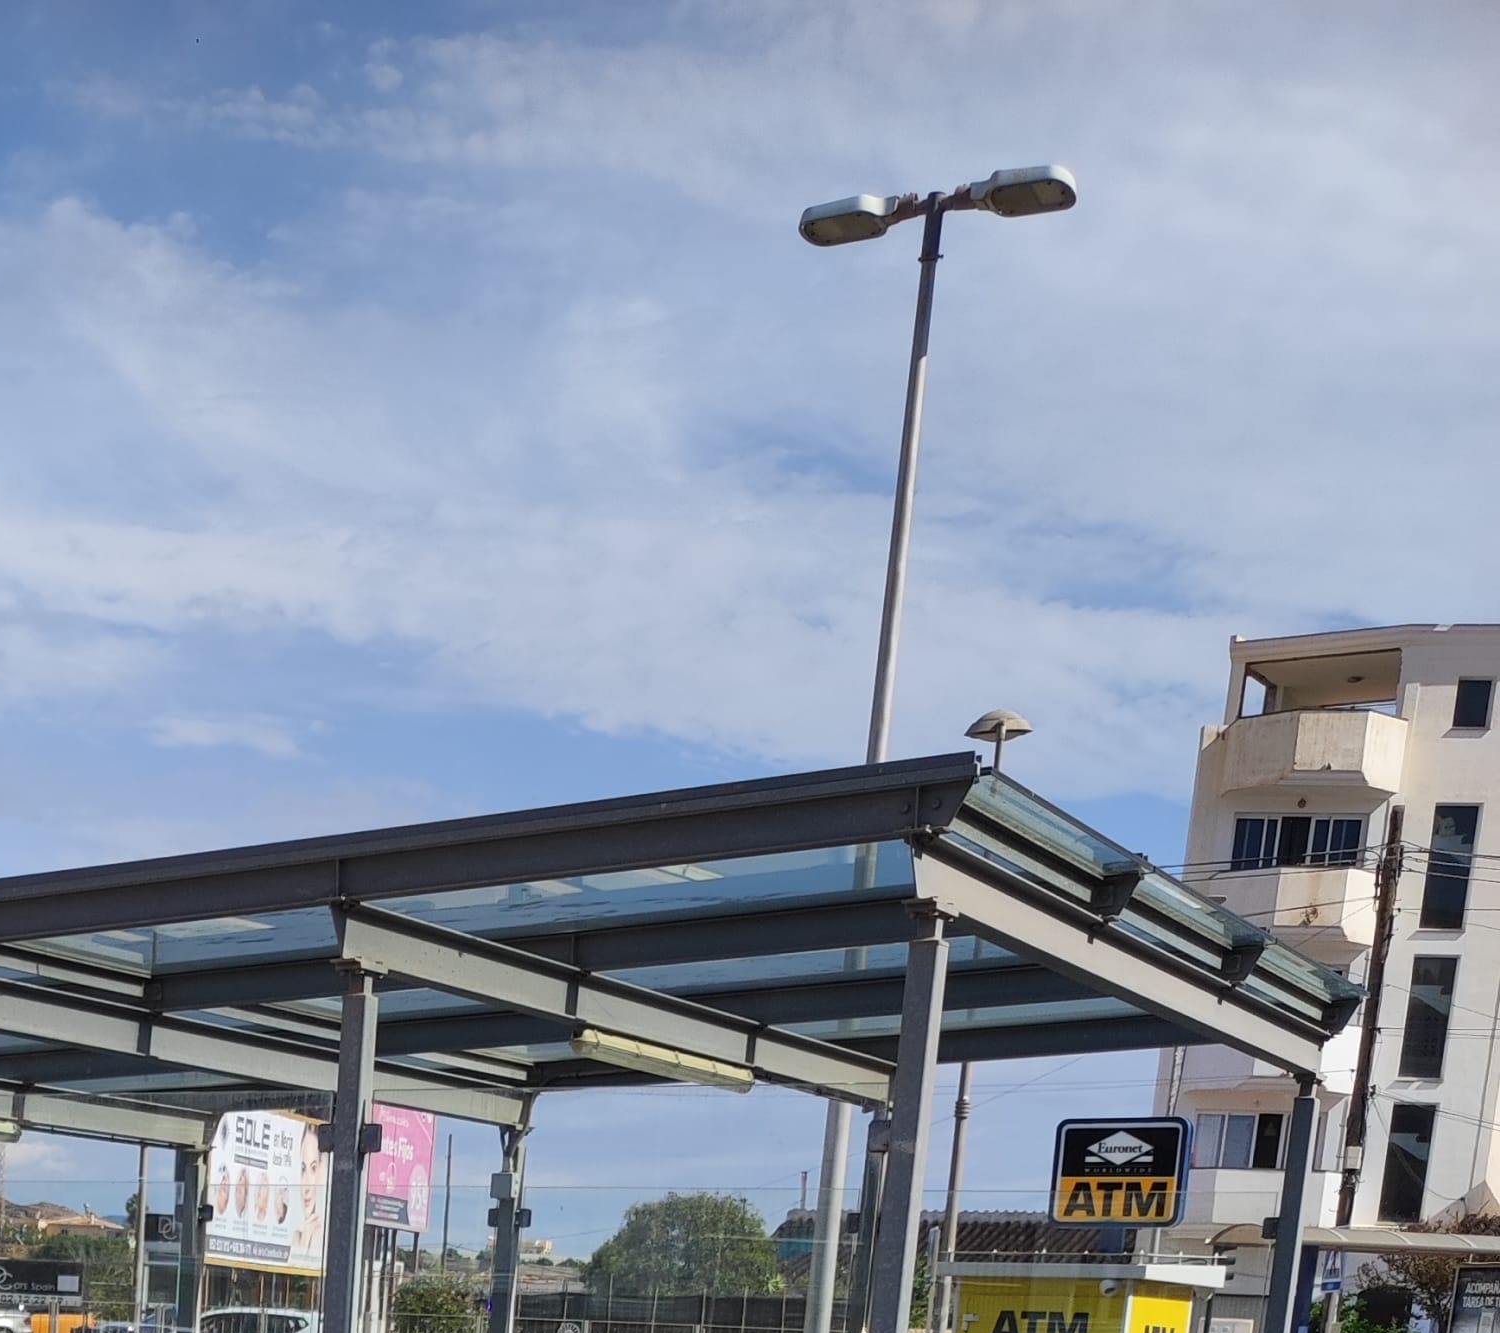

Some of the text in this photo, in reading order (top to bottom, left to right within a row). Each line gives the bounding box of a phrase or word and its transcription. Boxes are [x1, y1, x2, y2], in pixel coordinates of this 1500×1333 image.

[1098, 1142, 1143, 1154] Euronet
[1063, 1182, 1168, 1217] ATM
[31, 1282, 55, 1292] Spain
[1462, 1296, 1484, 1308] TAREA
